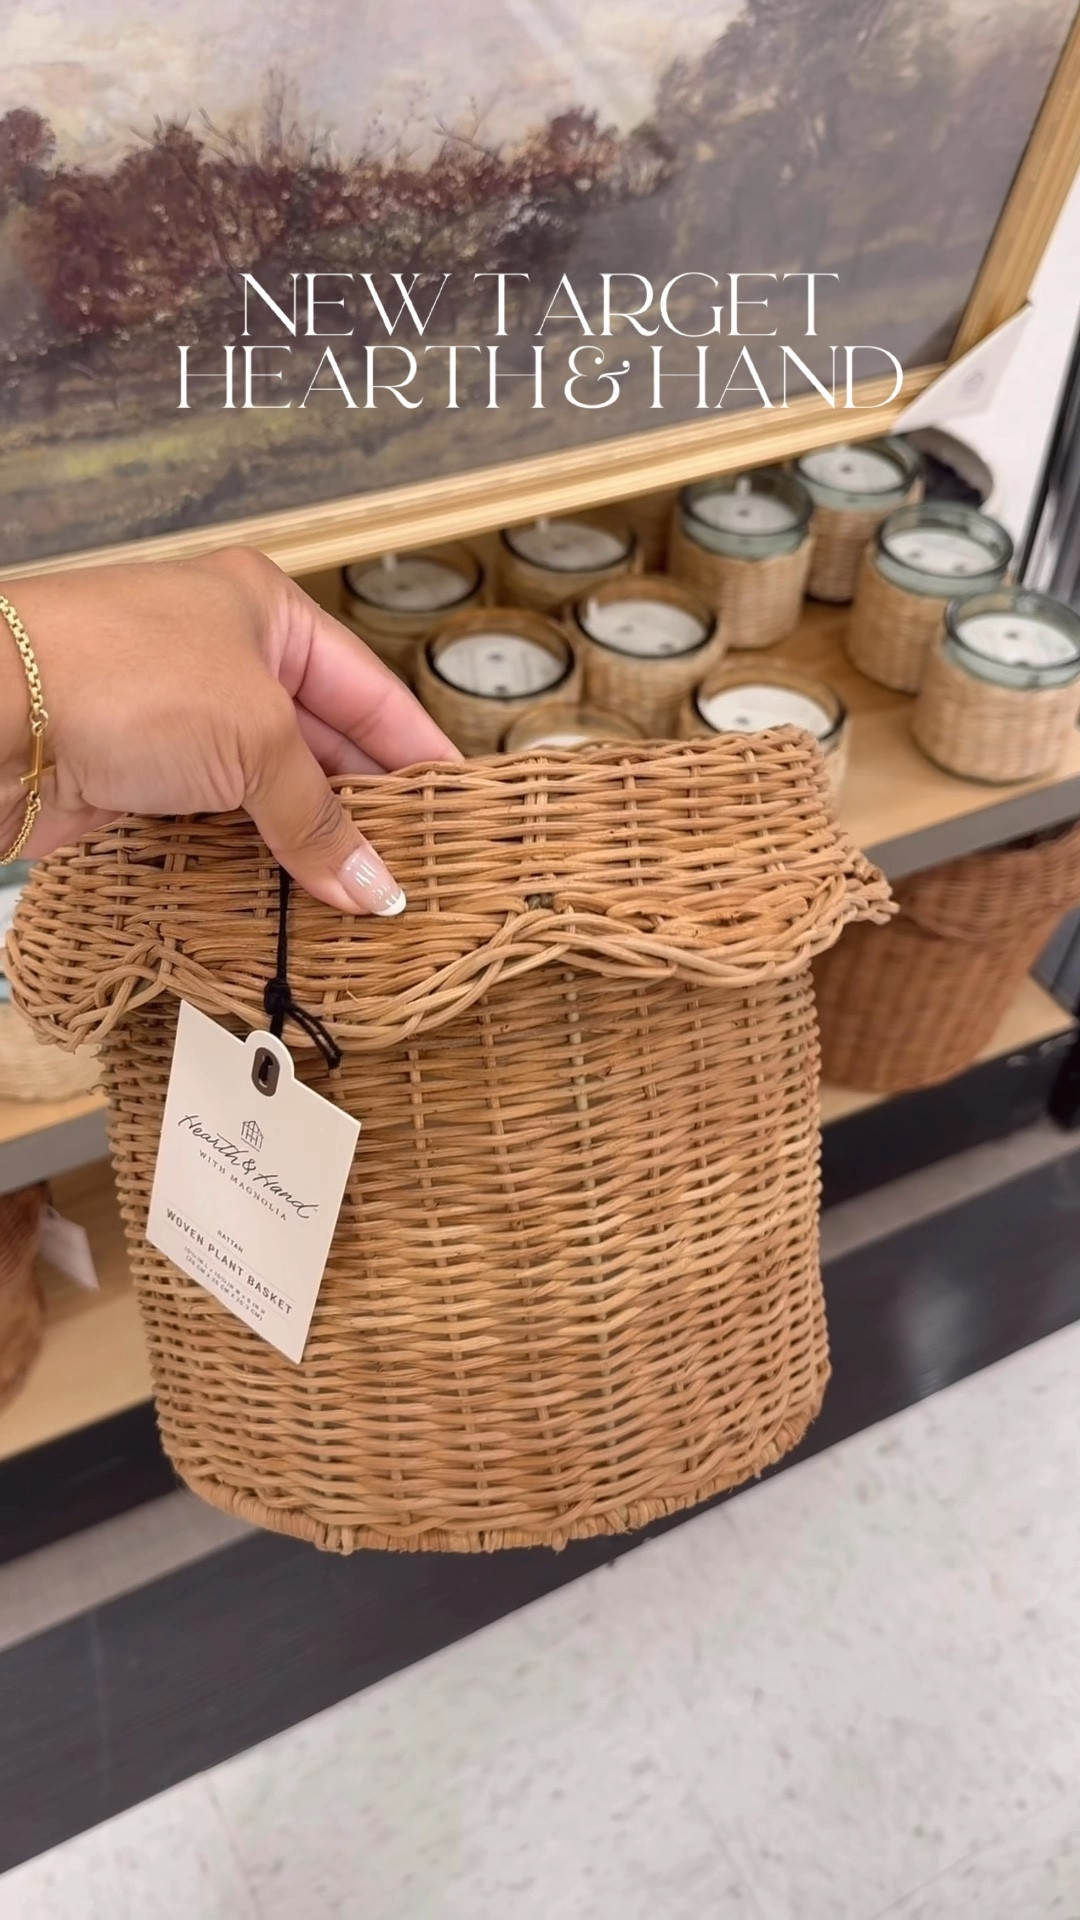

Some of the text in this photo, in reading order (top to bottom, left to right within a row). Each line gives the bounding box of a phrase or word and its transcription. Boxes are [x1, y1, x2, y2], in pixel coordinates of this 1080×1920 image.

[178, 1113, 319, 1220] Hearth & Hand
[199, 1149, 288, 1222] WITH MAGNOLIA
[166, 1207, 293, 1315] WOVEN PLANT BASKET
[217, 1229, 244, 1254] RATTAN
